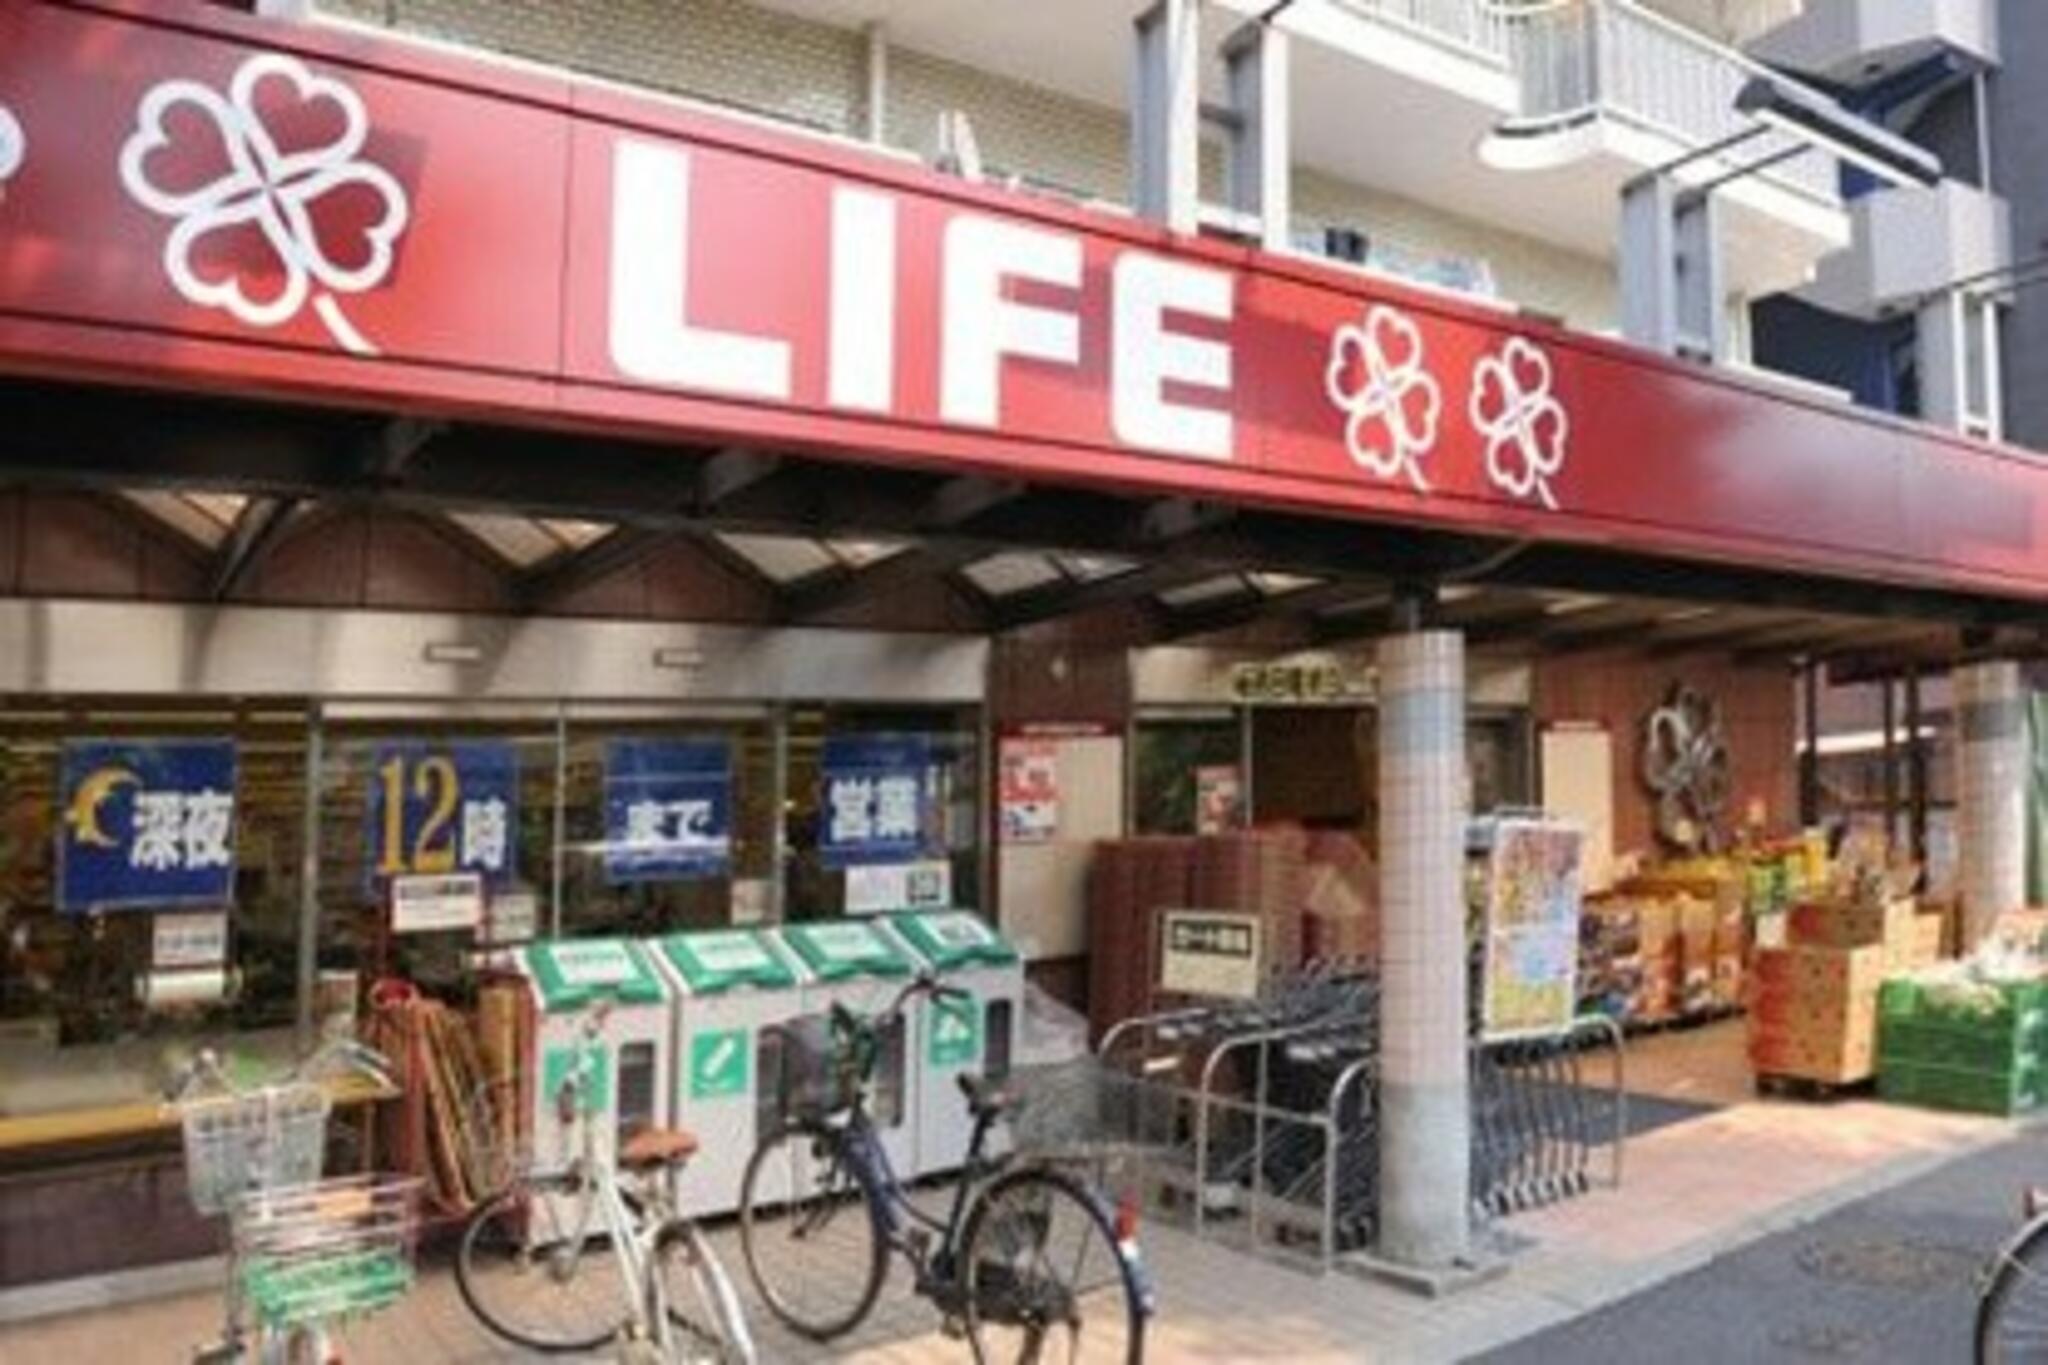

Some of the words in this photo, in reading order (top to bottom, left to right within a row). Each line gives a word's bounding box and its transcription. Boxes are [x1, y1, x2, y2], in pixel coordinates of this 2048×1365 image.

[610, 138, 1234, 460] LIFE
[131, 790, 234, 870] 深夜
[627, 798, 713, 847] まで
[830, 776, 918, 841] 営業
